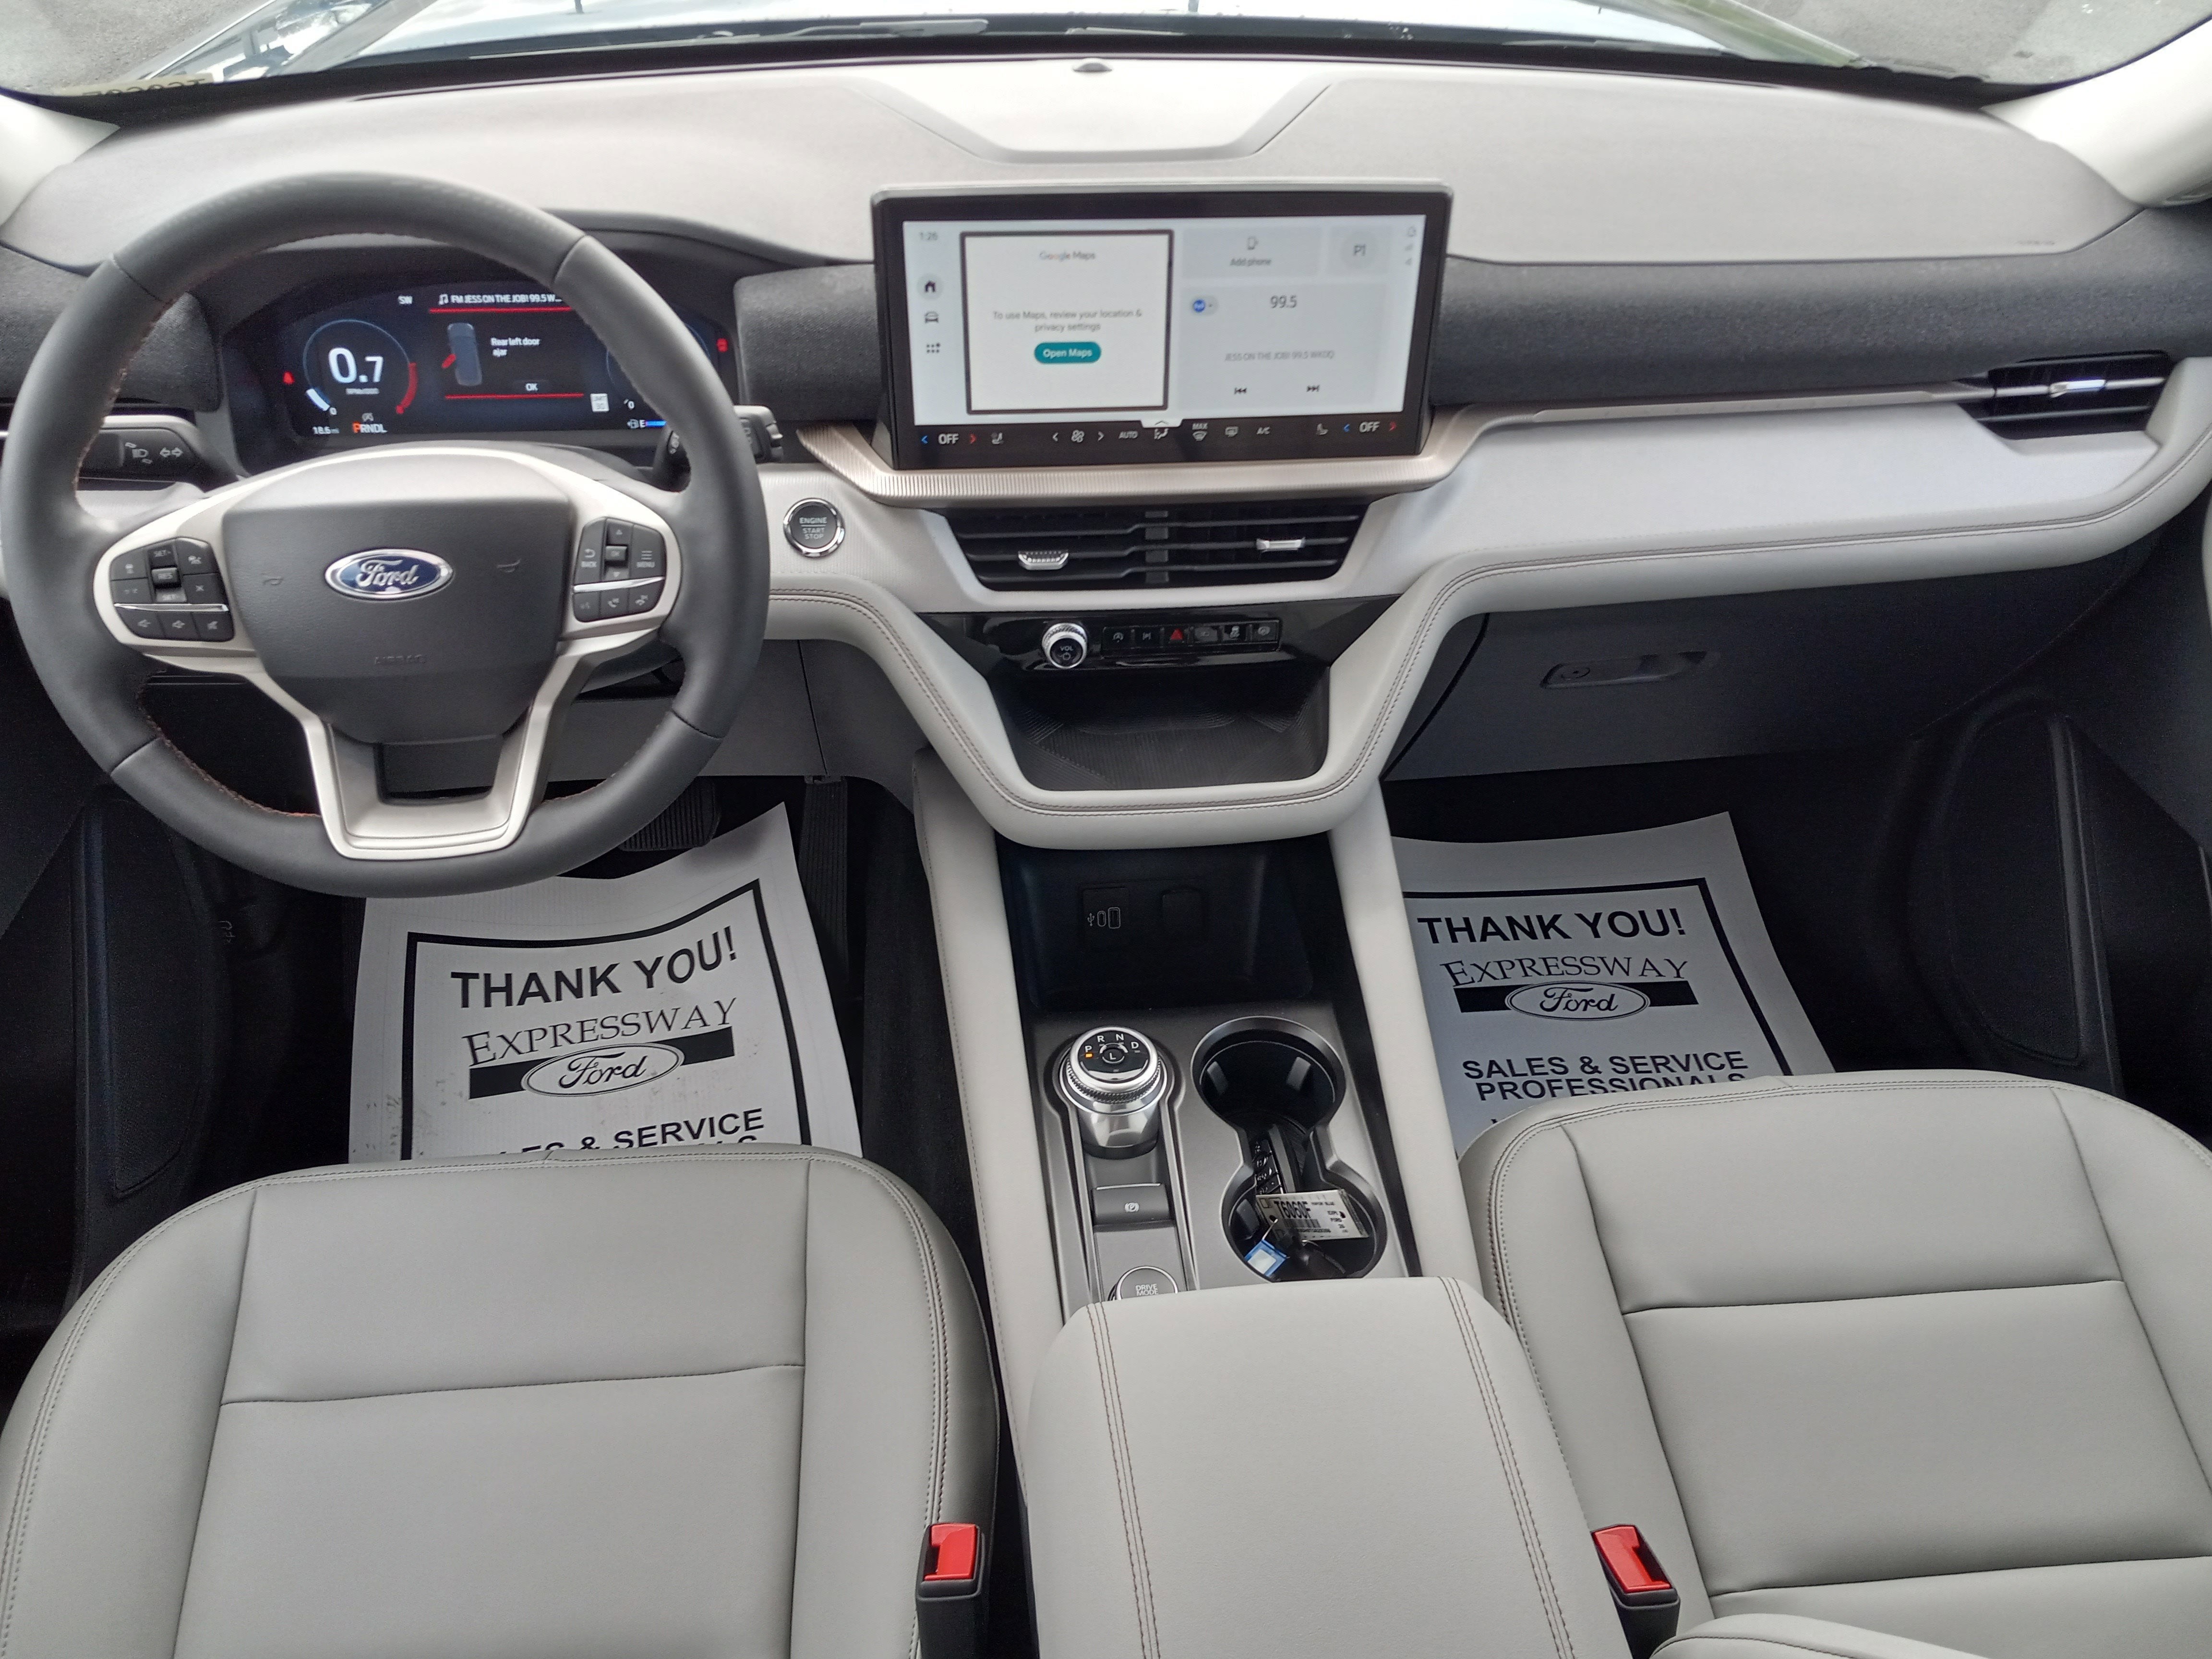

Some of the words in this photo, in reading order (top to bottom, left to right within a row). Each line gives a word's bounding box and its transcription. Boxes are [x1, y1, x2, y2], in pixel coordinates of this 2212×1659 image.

[1039, 251, 1071, 261] Google
[1072, 251, 1096, 261] Maps
[398, 296, 413, 304] SW
[482, 294, 495, 303] ON
[494, 294, 511, 303] THE
[1270, 295, 1297, 309] 99.5
[993, 311, 1003, 319] To
[1049, 311, 1077, 319] review
[1079, 312, 1097, 320] your
[1100, 310, 1134, 319] location
[1034, 324, 1065, 333] privacy
[1067, 323, 1101, 332] settings
[491, 337, 508, 346] Rear
[522, 337, 540, 346] door
[1043, 348, 1067, 360] Open
[1069, 348, 1093, 359] Maps
[329, 348, 384, 384] 0.7
[1359, 421, 1380, 433] OFF
[938, 433, 959, 445] OFF
[1118, 431, 1138, 439] AUTO
[356, 559, 420, 587] Ford
[1418, 914, 1572, 944] THANK
[1574, 908, 1686, 940] YOU!
[451, 963, 621, 1008] THANK
[633, 926, 738, 989] YOU!
[1440, 956, 1689, 987] EXPRESSWAY
[1539, 986, 1619, 1012] Ford
[462, 997, 737, 1067] EXPRESSWAY
[558, 1051, 649, 1089] Ford
[1462, 1056, 1569, 1079] SALES
[1580, 1056, 1602, 1075] &
[1611, 1050, 1749, 1074] SERVICE
[613, 1107, 765, 1149] SERVICE
